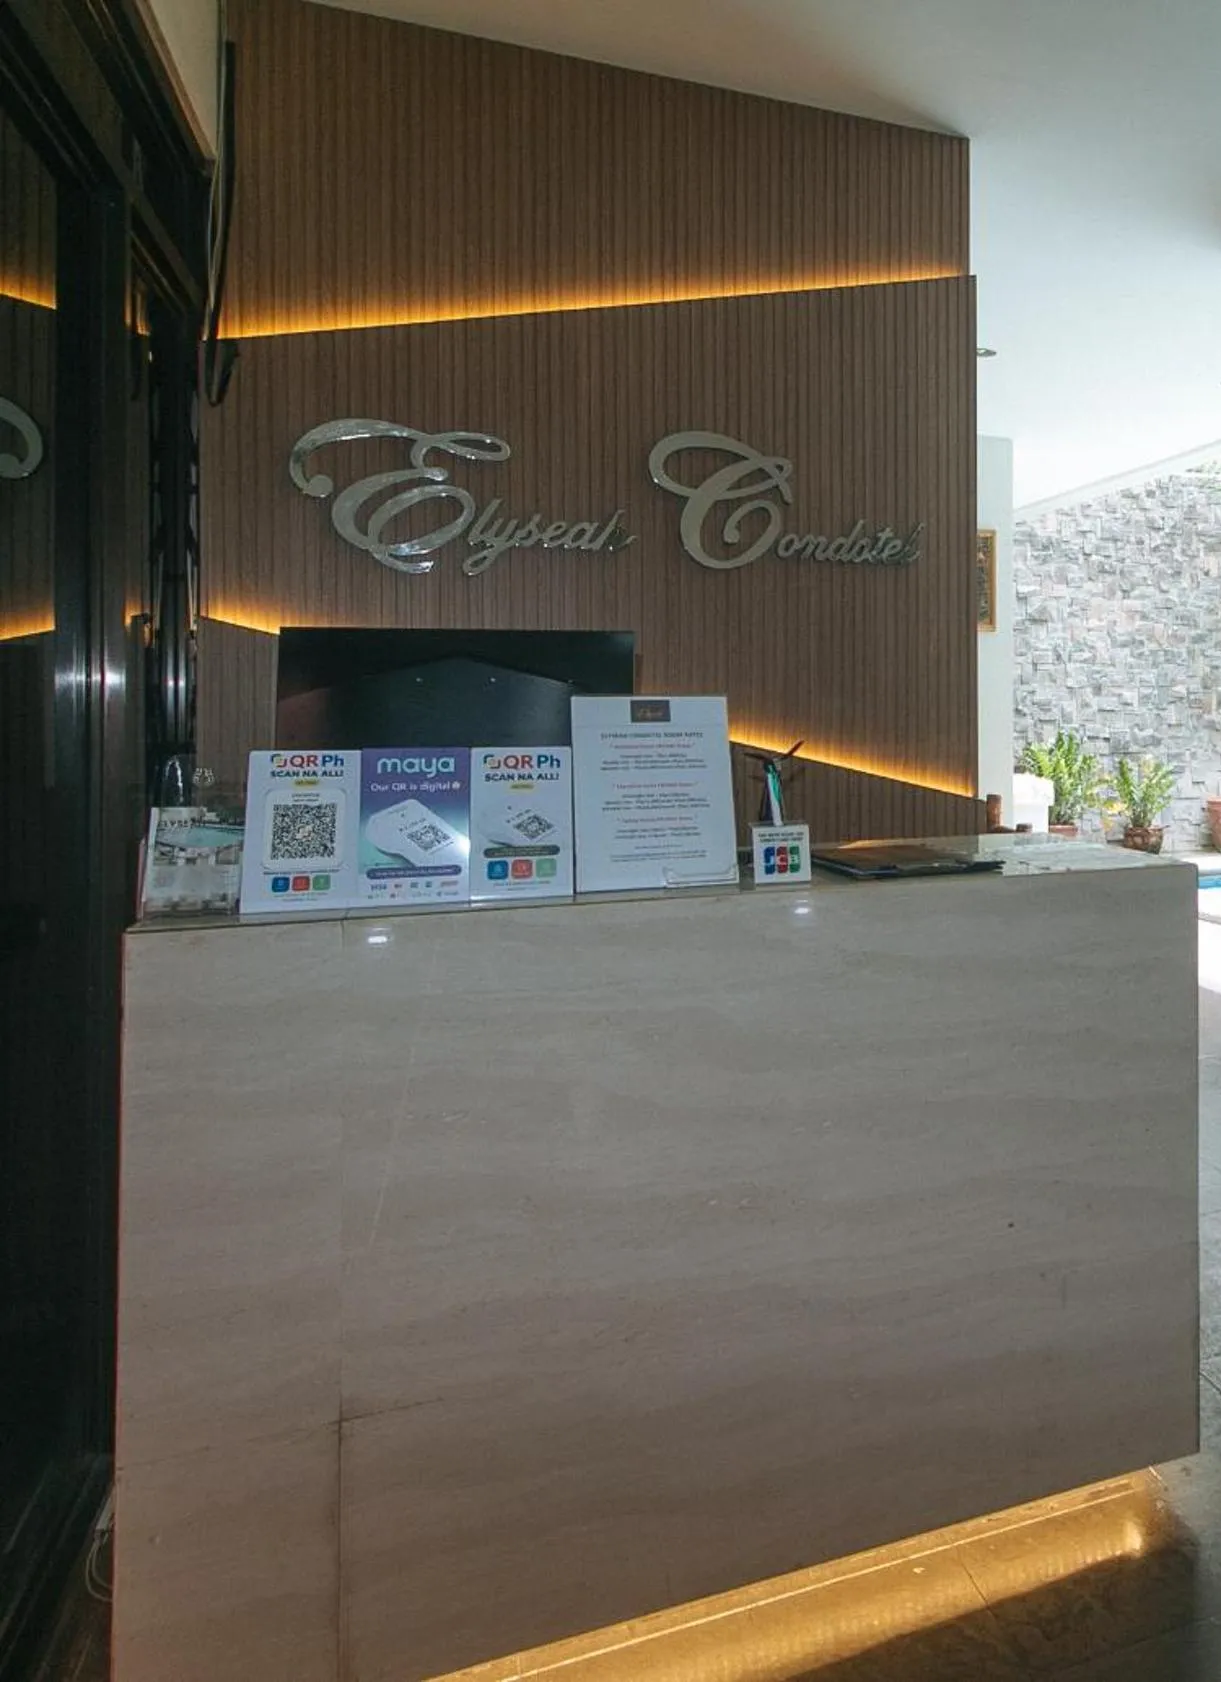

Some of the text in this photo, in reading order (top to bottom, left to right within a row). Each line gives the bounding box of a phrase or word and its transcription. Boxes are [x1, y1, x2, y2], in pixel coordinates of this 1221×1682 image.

[290, 754, 345, 769] QR Ph
[377, 756, 456, 778] maya
[503, 754, 561, 769] QR Ph
[270, 770, 300, 778] SCAN
[484, 772, 515, 782] SCAN
[370, 780, 450, 792] Our QR is digital
